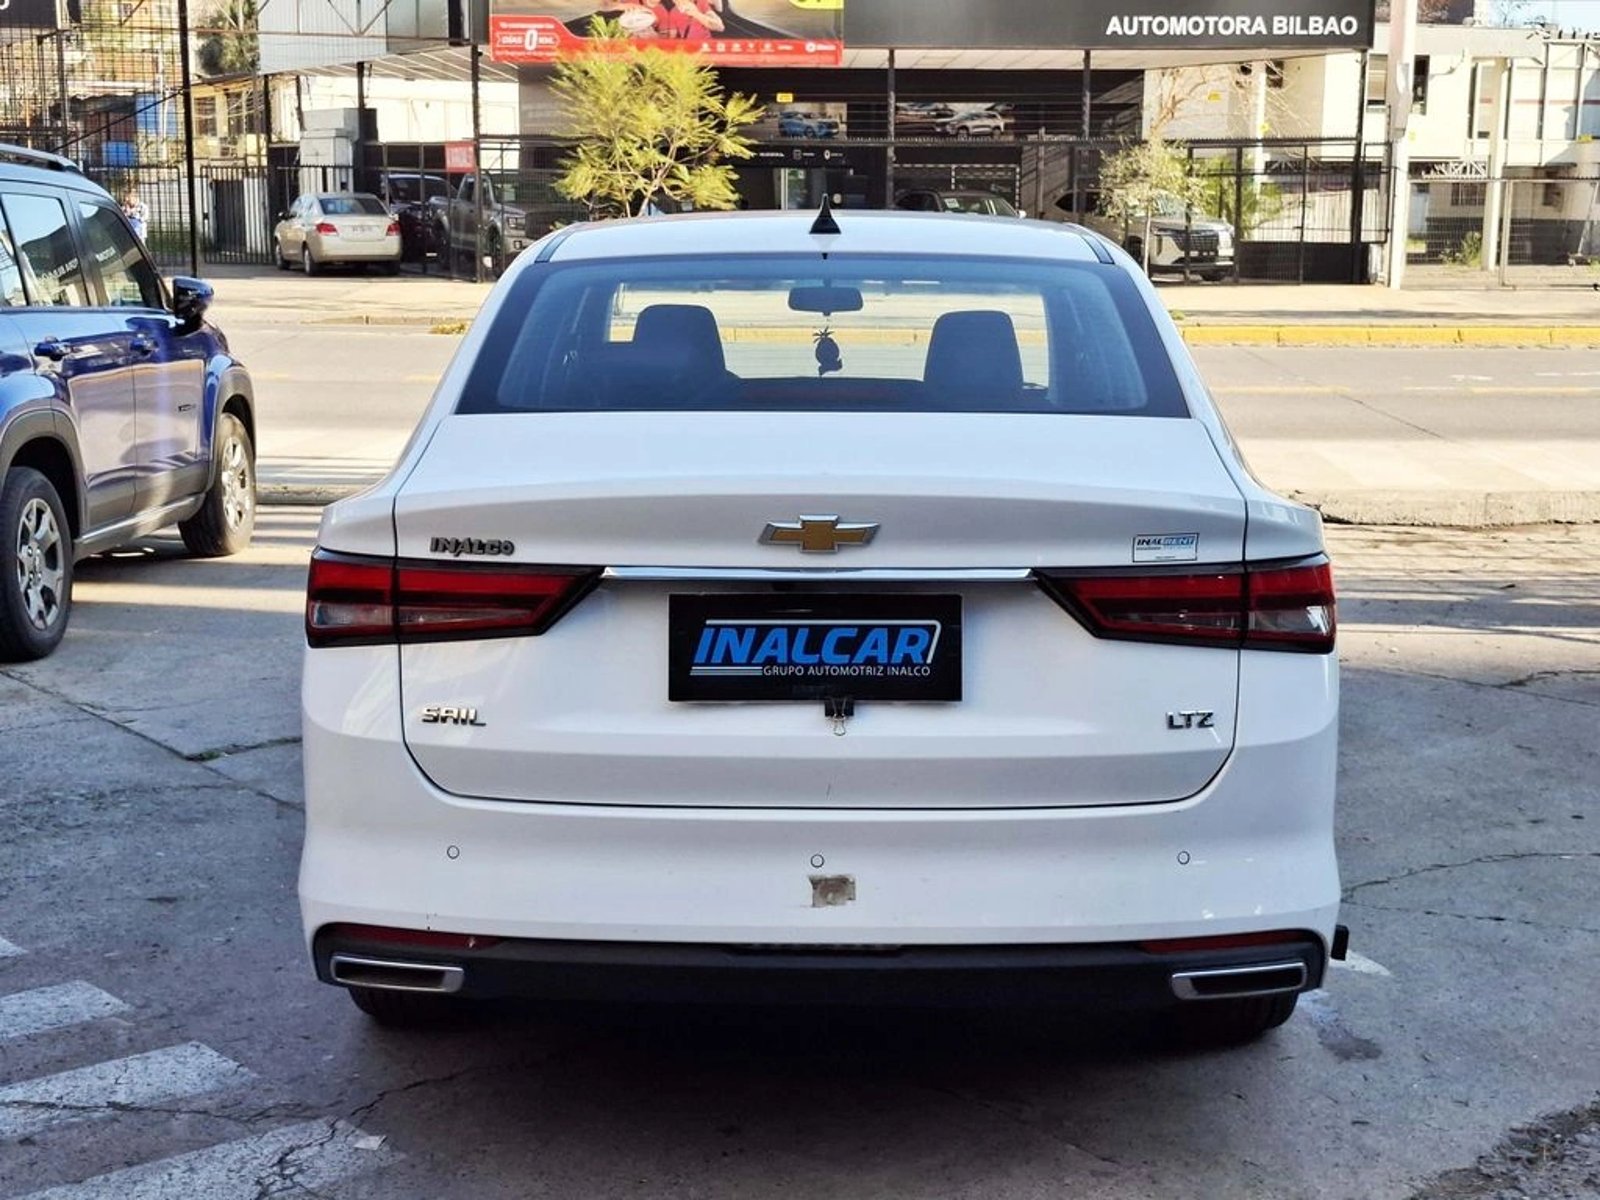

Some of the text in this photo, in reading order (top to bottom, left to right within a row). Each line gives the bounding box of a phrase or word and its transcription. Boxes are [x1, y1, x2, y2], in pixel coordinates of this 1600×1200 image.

[1105, 15, 1358, 35] AUTOMOTORA BILBAO
[429, 536, 515, 557] INALCO
[693, 627, 931, 664] INALCAR
[763, 665, 931, 677] GRUPO AUTOMOTRIZ INALCO
[421, 706, 487, 726] SAIL
[1166, 710, 1214, 729] LTZ
